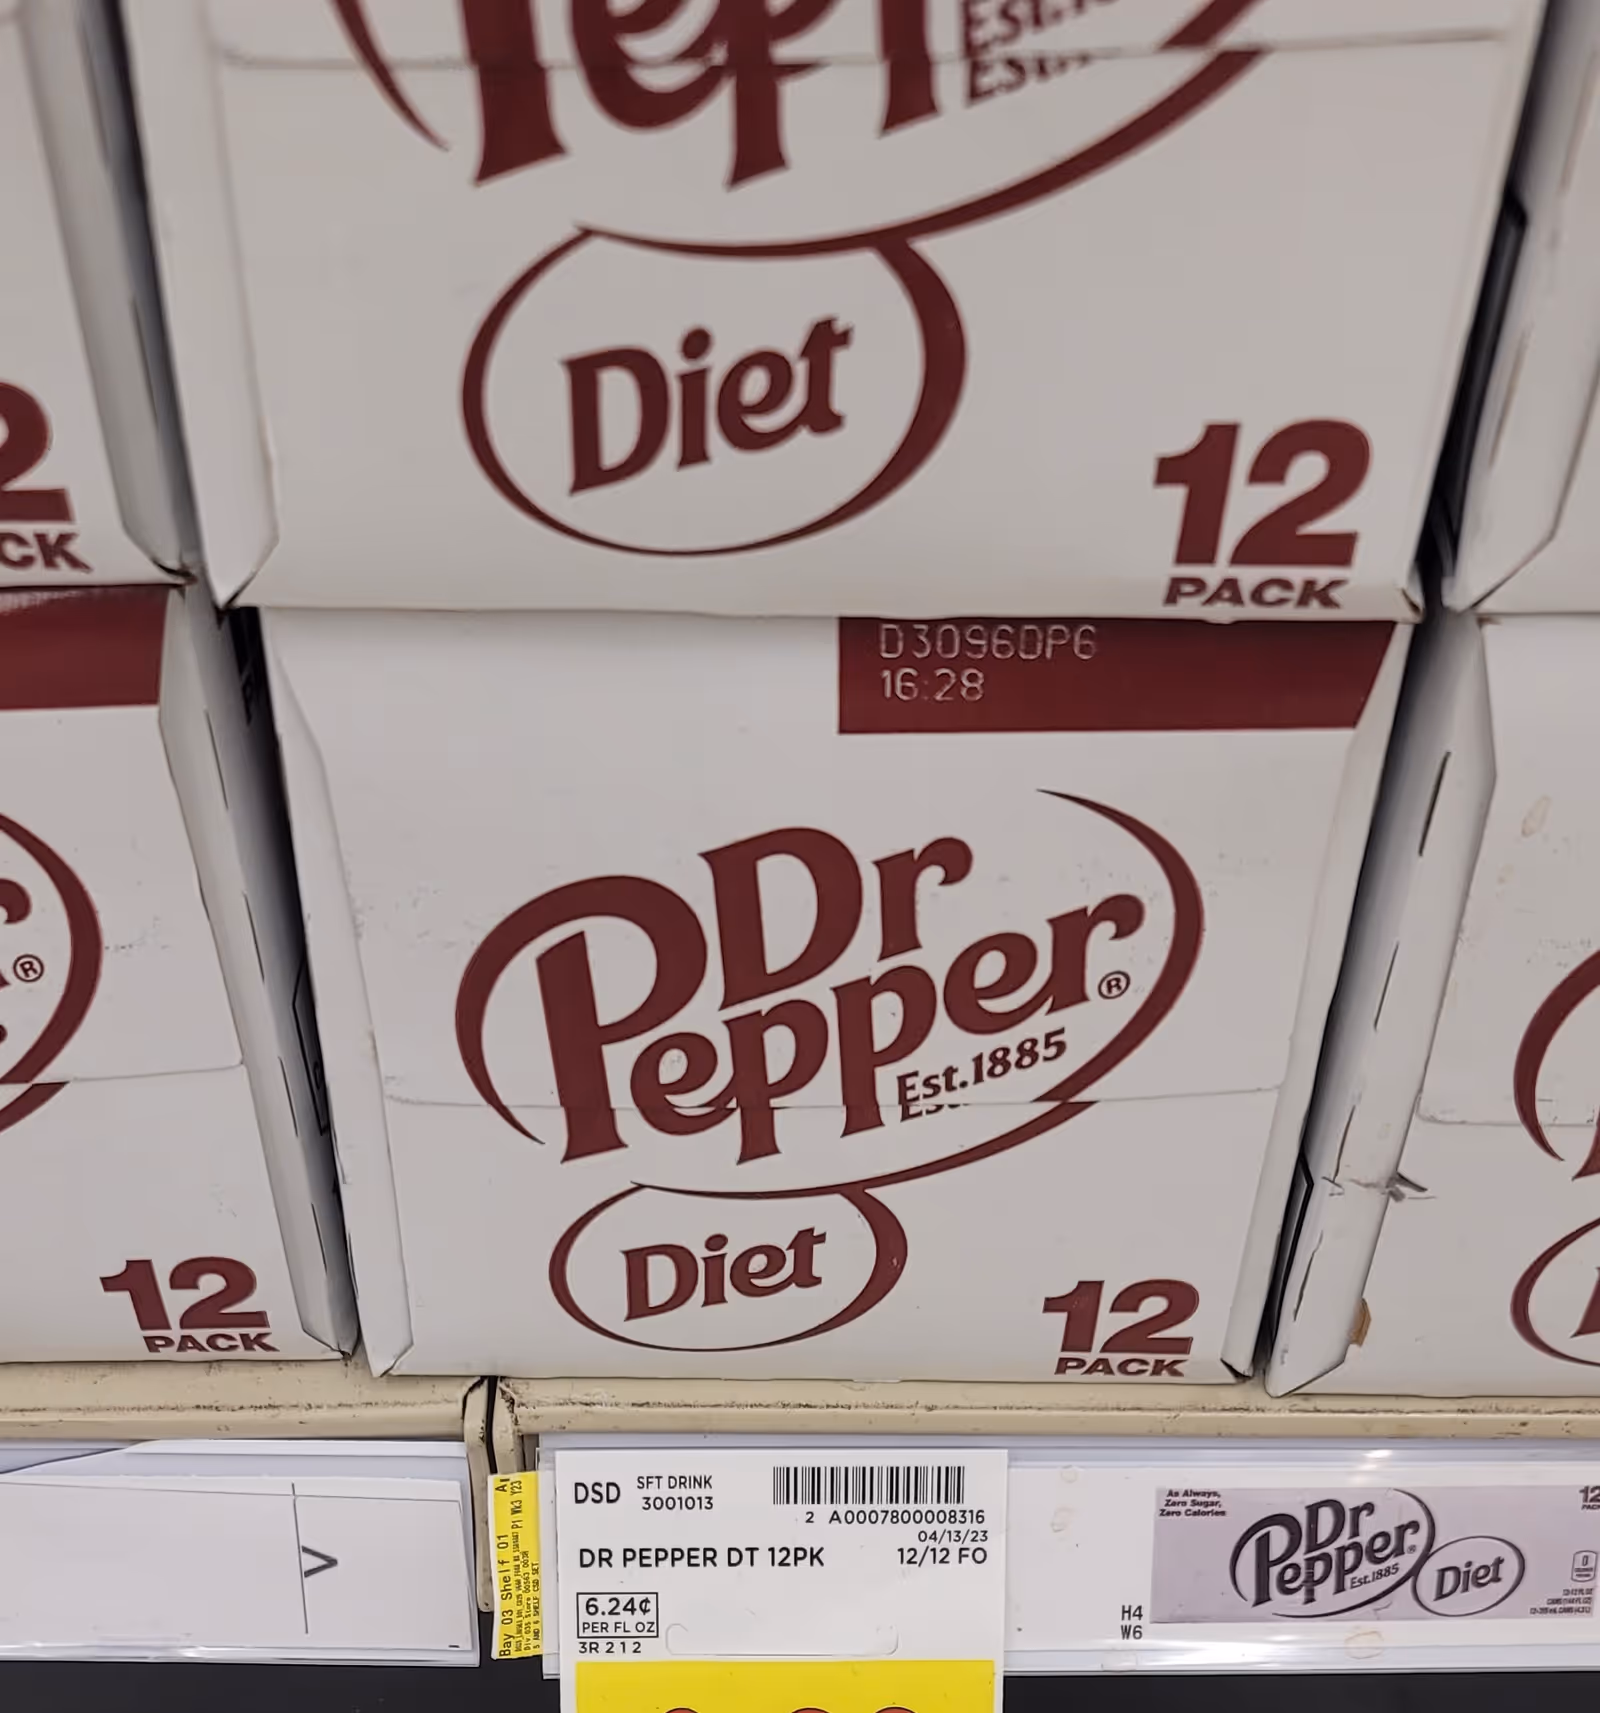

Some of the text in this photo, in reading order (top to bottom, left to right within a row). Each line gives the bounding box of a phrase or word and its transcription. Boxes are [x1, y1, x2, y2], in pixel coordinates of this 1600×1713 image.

[560, 317, 853, 495] Diet
[0, 381, 76, 522] 2
[1154, 417, 1371, 569] 12
[0, 532, 94, 574] CK
[1162, 577, 1351, 610] PACK
[880, 667, 985, 701] 16:28
[698, 827, 973, 1011] Dr
[455, 875, 1146, 1164] Pepper
[896, 1027, 1067, 1106] Est.1885
[622, 1224, 826, 1323] Diet
[99, 1256, 271, 1332] 12
[1042, 1278, 1200, 1355] 12
[144, 1332, 280, 1354] PACK
[1053, 1358, 1189, 1377] PACK
[510, 1480, 523, 1496] Y23
[573, 1482, 621, 1504] DSD
[637, 1475, 713, 1490] SFT DRINK
[1166, 1489, 1221, 1498] As Always,
[642, 1496, 714, 1511] 3001013
[1159, 1508, 1226, 1517] Zero Calories
[1164, 1499, 1221, 1508] Zero Sugar,
[805, 1510, 986, 1525] 2 A0007800008316
[1303, 1499, 1375, 1555] Dr
[497, 1534, 509, 1550] 01
[918, 1530, 989, 1544] 04/13/23
[579, 1547, 825, 1568] DR PEPPER DT 12PK
[898, 1547, 988, 1567] 12/12 FO
[1230, 1513, 1420, 1608] Pepper
[498, 1559, 513, 1601] Shelf
[1350, 1563, 1400, 1589] Est.1885
[1432, 1556, 1505, 1601] Diet
[501, 1609, 514, 1626] 03
[585, 1597, 652, 1616] 6.24¢
[1121, 1605, 1143, 1621] H4
[582, 1622, 656, 1633] PER FL OZ
[1121, 1625, 1143, 1640] W6
[499, 1634, 515, 1657] Bay
[579, 1642, 600, 1654] 3R
[605, 1642, 615, 1654] 2
[632, 1642, 642, 1654] 2
